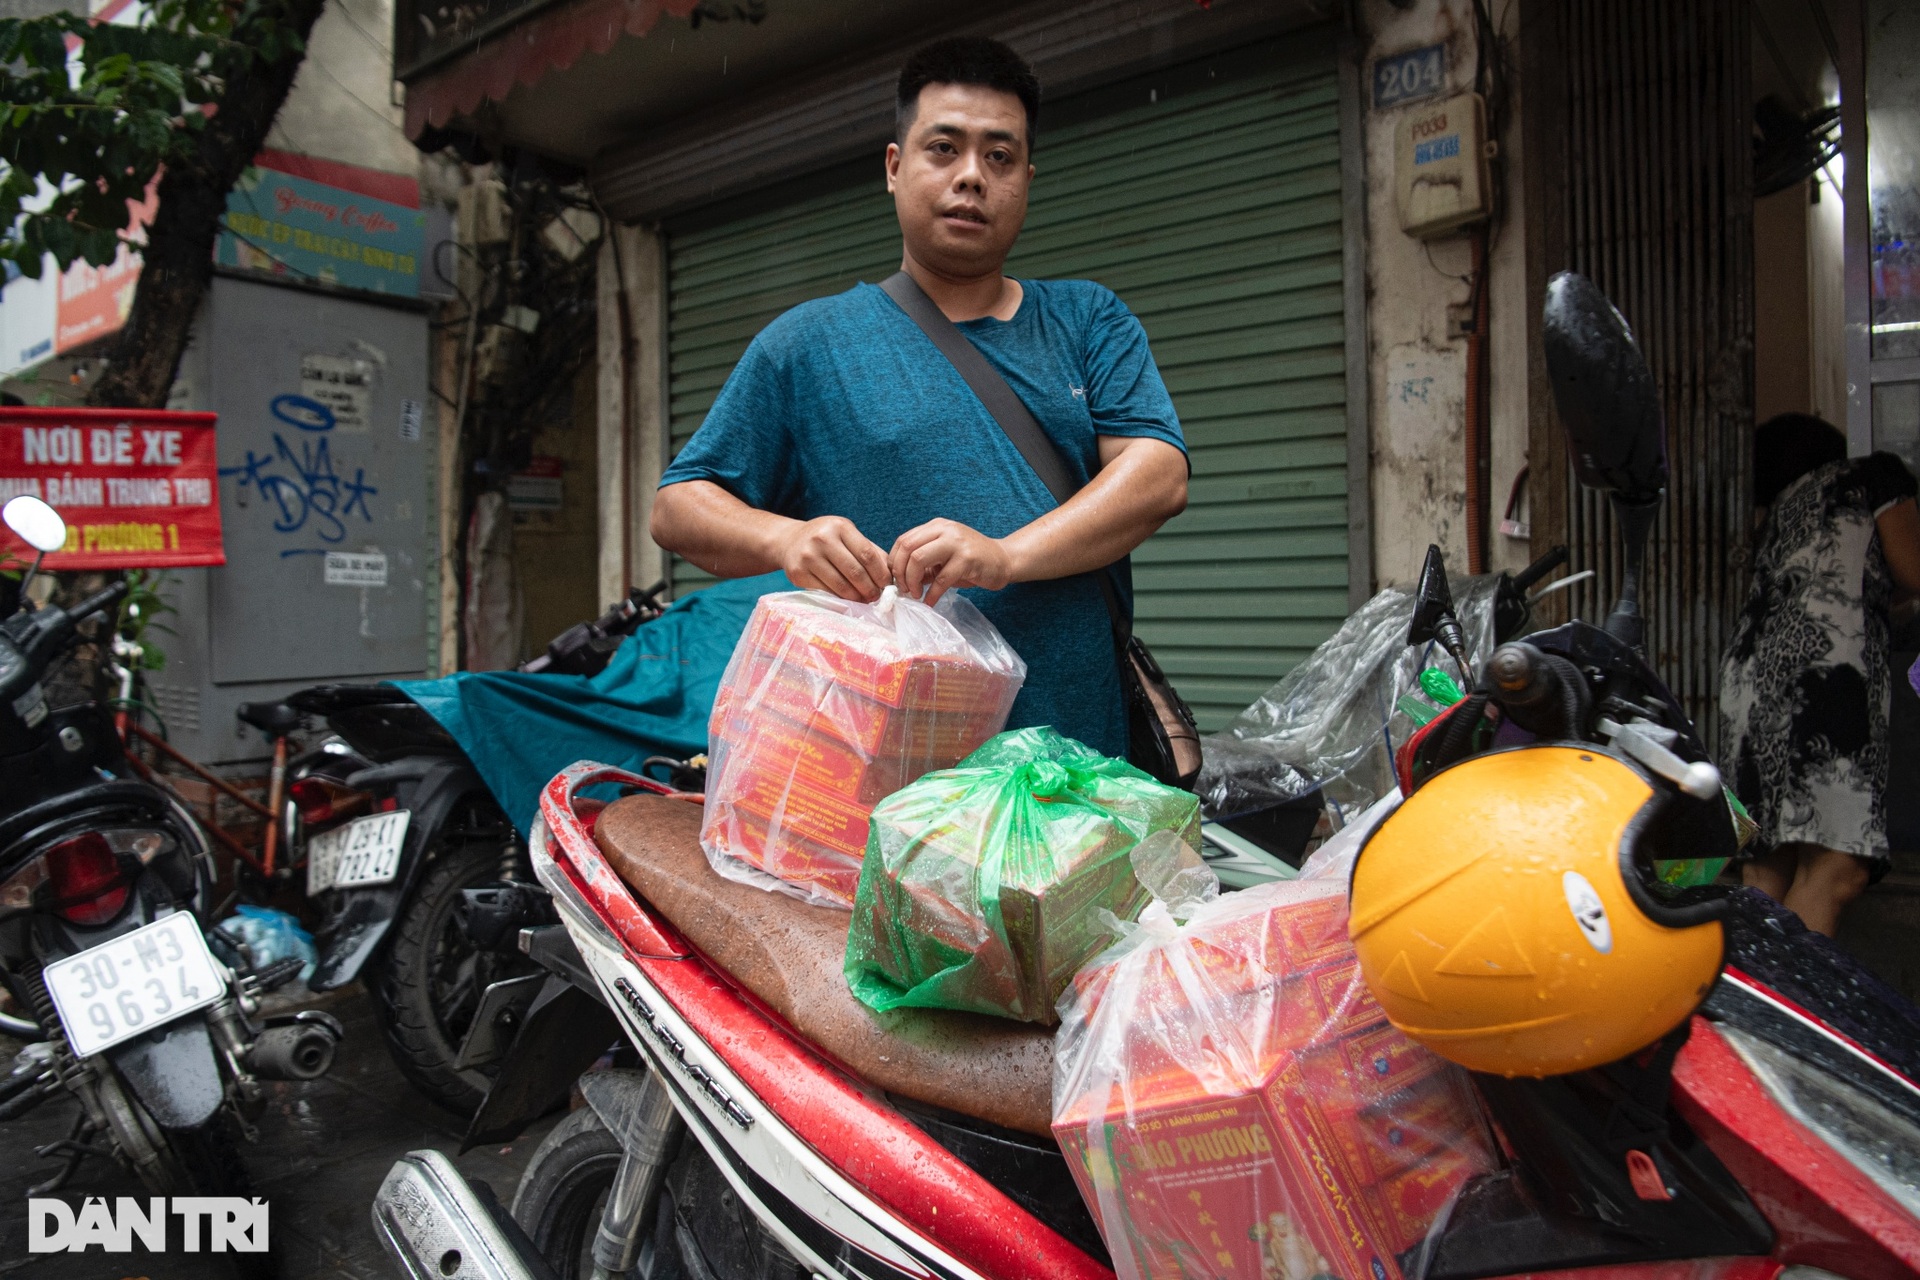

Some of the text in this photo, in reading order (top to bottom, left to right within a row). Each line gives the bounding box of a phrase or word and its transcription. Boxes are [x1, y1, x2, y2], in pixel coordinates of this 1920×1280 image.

[1380, 51, 1441, 99] 204
[23, 421, 183, 466] NƠI ĐỂ XE
[107, 477, 171, 507] TRUNG
[173, 477, 211, 506] THU
[83, 521, 164, 553] PHƯƠNG
[167, 523, 179, 550] 1
[70, 927, 184, 999] 30-M3
[87, 966, 200, 1040] 9634
[696, 1085, 734, 1127] EDITION
[1193, 1110, 1220, 1123] TRUNG
[1221, 1107, 1238, 1118] THU
[1176, 1123, 1273, 1165] PHƯƠNG
